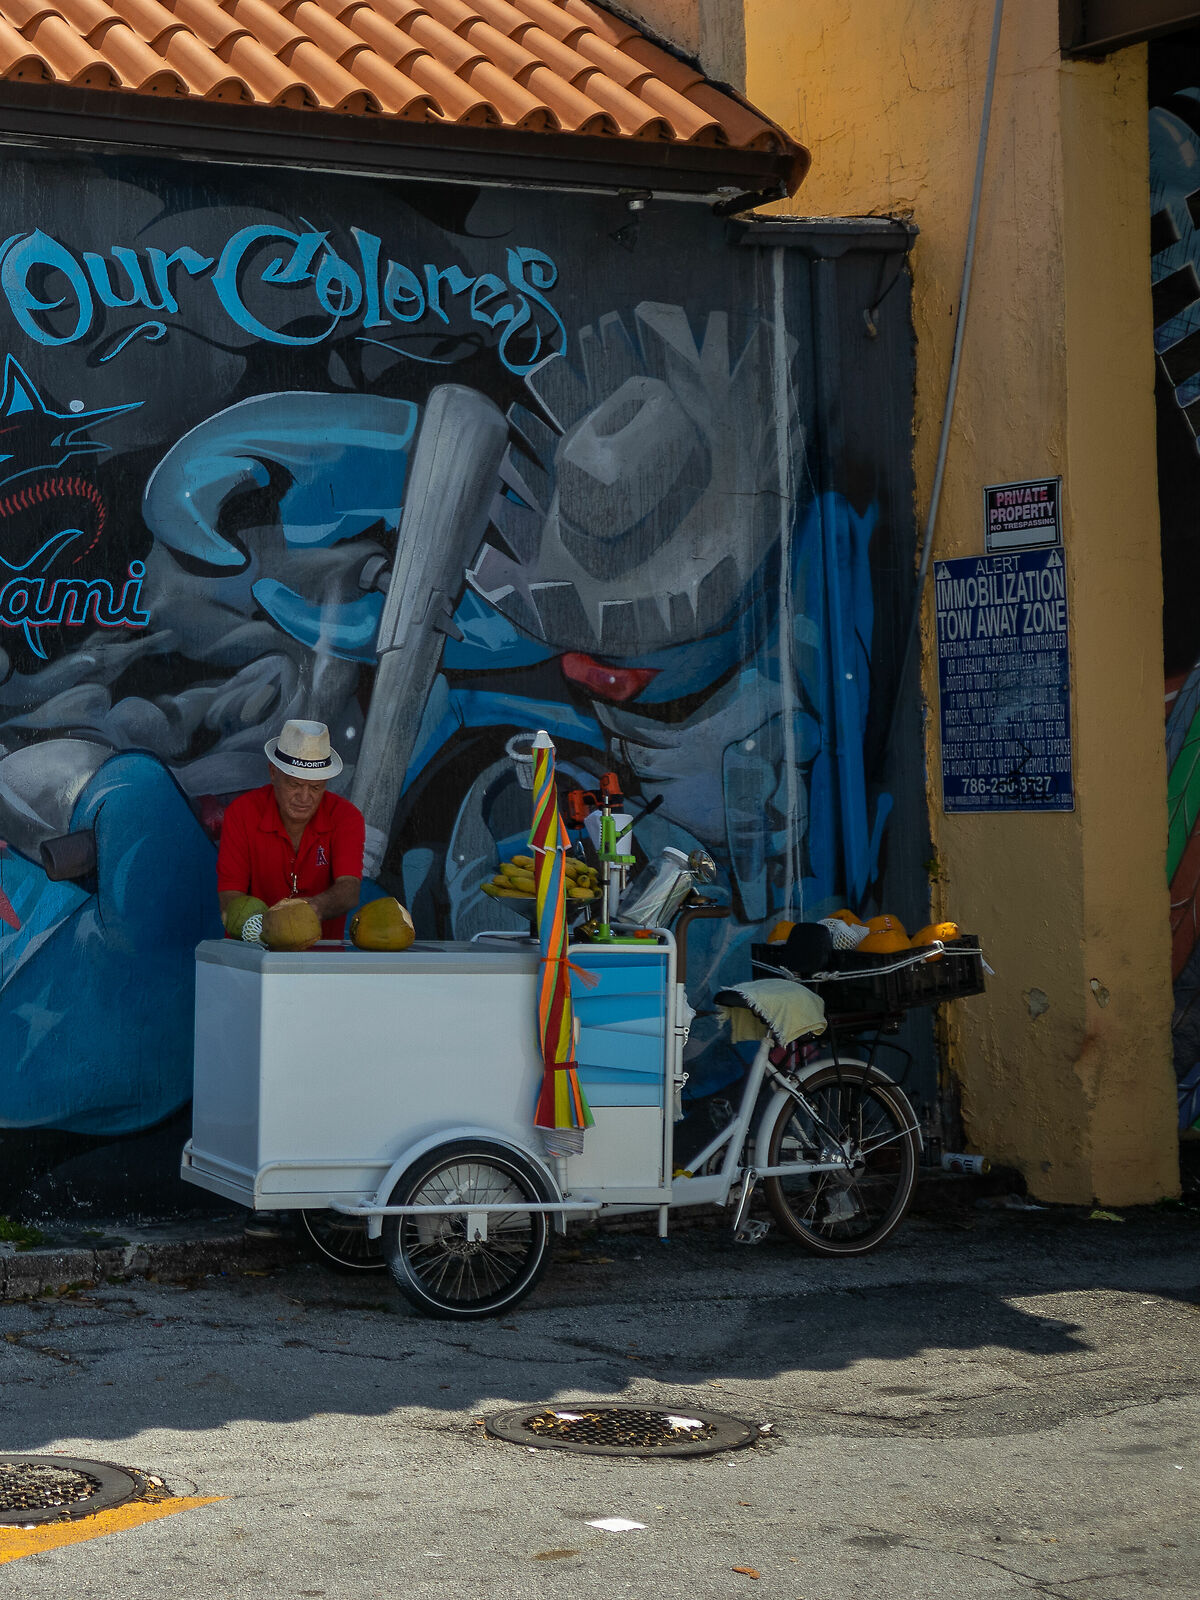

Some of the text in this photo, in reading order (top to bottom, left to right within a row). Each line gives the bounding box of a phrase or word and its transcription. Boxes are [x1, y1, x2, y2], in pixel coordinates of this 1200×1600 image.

[211, 217, 567, 376] Colores
[996, 486, 1048, 506] PRIVATE
[990, 501, 1055, 523] PROPERTY
[1003, 517, 1056, 530] TRESPASSING
[975, 555, 1021, 576] ALERT
[937, 567, 1065, 611] IMMOBILIZATION
[937, 600, 1067, 641] TOW AWAY ZONE
[940, 640, 967, 657] ENTERING
[968, 639, 990, 655] PRIVATE
[1021, 632, 1066, 651] UNAUTHORIZED
[947, 659, 955, 674] OR
[957, 657, 983, 673] ILLEGALLY
[984, 655, 1006, 671] PARKED
[965, 674, 972, 690] OR
[973, 673, 990, 689] TOWED
[967, 692, 981, 707] PARK
[1045, 721, 1054, 737] FEE
[1055, 721, 1065, 736] FOR
[942, 743, 963, 758] RELEASE
[964, 743, 971, 758] OF
[972, 742, 993, 757] VEHICLE
[995, 741, 1002, 757] OR
[1047, 739, 1070, 755] EXPENSE
[292, 759, 327, 769] MAJORITY
[943, 760, 949, 775] 24
[977, 759, 990, 774] DAYS
[992, 759, 996, 774] A
[998, 758, 1014, 774] WEEK
[1016, 758, 1023, 773] TO
[1024, 757, 1047, 773] REMOVE
[1049, 757, 1053, 772] A
[1055, 756, 1070, 772] BOOT
